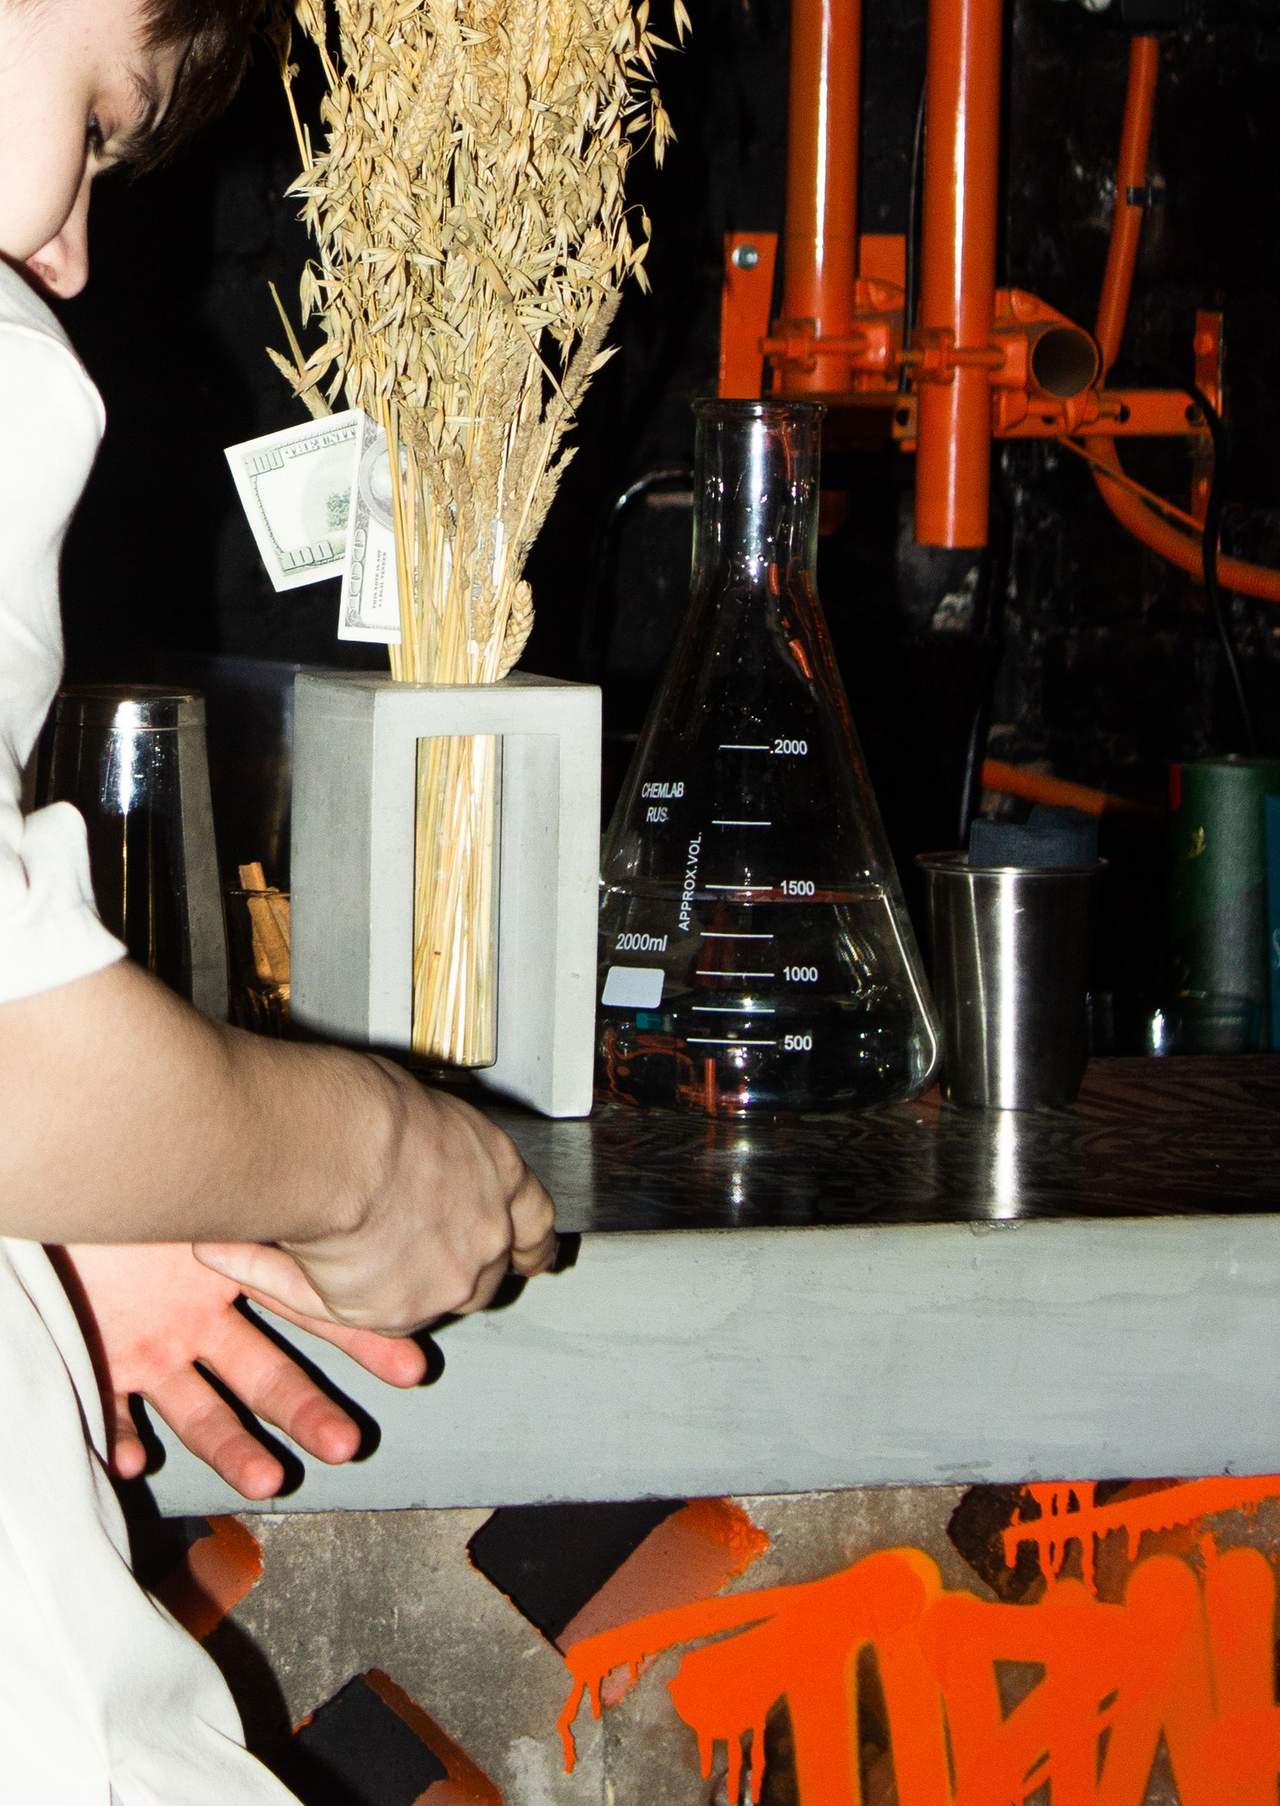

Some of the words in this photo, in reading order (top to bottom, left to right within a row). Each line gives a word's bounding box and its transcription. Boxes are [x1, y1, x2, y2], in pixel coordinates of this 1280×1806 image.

[773, 738, 808, 755] 2000
[641, 781, 685, 798] CHEMLAB
[780, 880, 815, 896] 1500
[615, 933, 668, 952] 2000ml
[782, 966, 818, 982] 1000
[783, 1035, 812, 1051] 500
